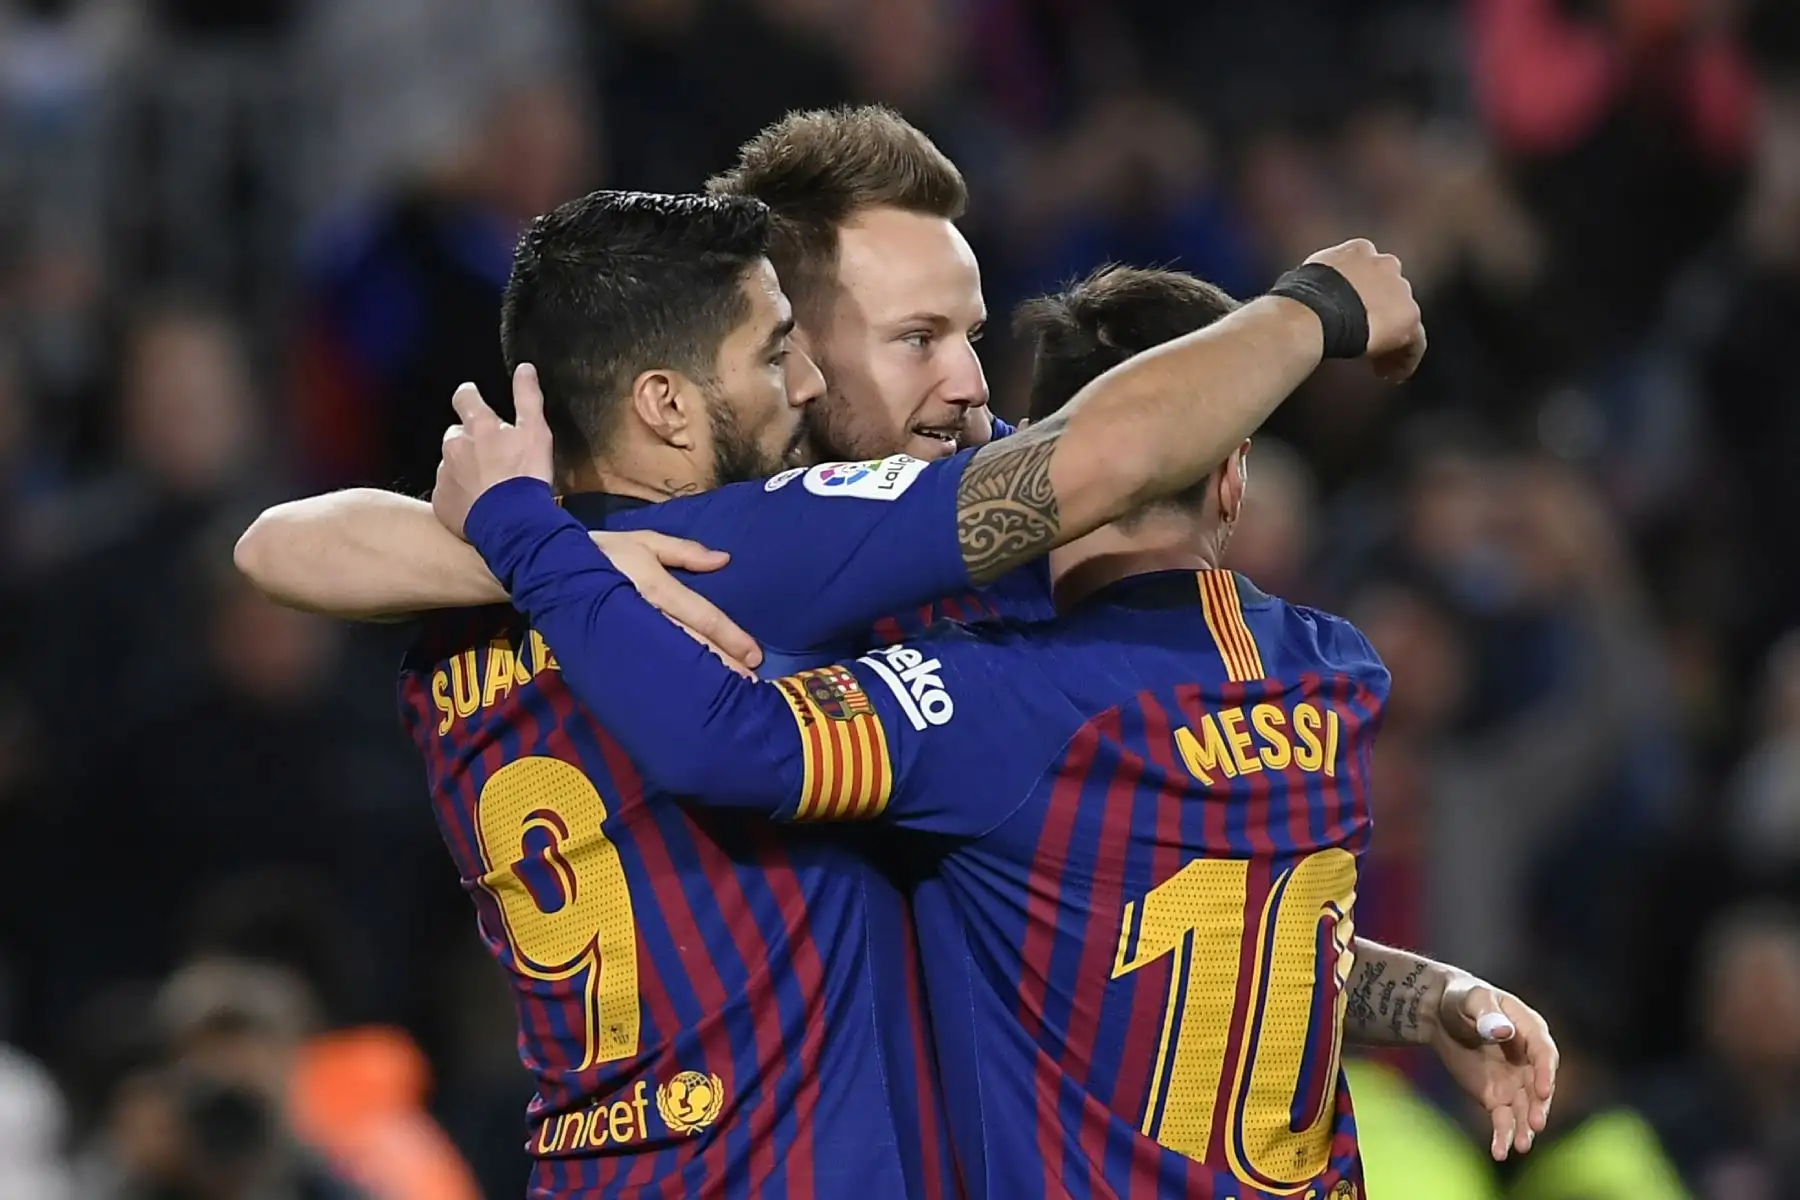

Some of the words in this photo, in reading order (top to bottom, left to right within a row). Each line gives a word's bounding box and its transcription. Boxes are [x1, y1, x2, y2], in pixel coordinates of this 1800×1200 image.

[1174, 703, 1338, 786] MESSI
[474, 756, 640, 1072] 9
[538, 1081, 649, 1155] unicef
[1111, 847, 1357, 1196] 10
